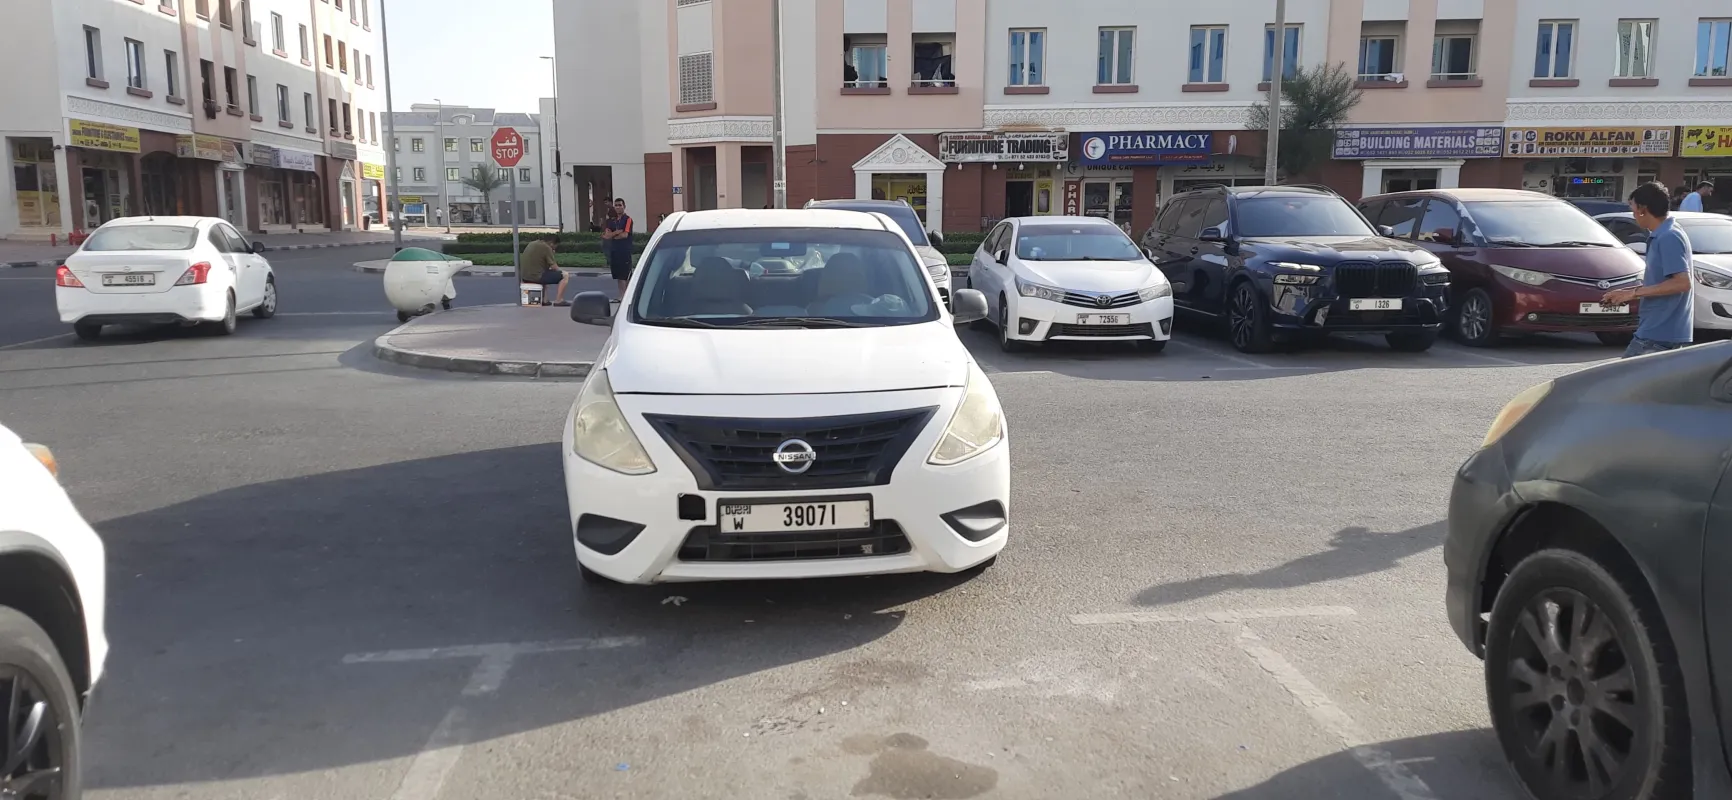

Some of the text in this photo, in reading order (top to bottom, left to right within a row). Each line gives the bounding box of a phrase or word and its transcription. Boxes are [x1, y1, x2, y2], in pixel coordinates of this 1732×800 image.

[496, 132, 517, 146] قف
[1108, 134, 1209, 150] PHARMACY
[1360, 136, 1475, 149] BUILDING MATERIALS
[1544, 131, 1635, 141] ROKN ALFAN
[1718, 135, 1732, 148] H
[948, 139, 1051, 154] FURNITURE TRADING
[495, 148, 519, 159] STOP
[1374, 300, 1390, 308] 1326
[733, 504, 836, 530] W 39071
